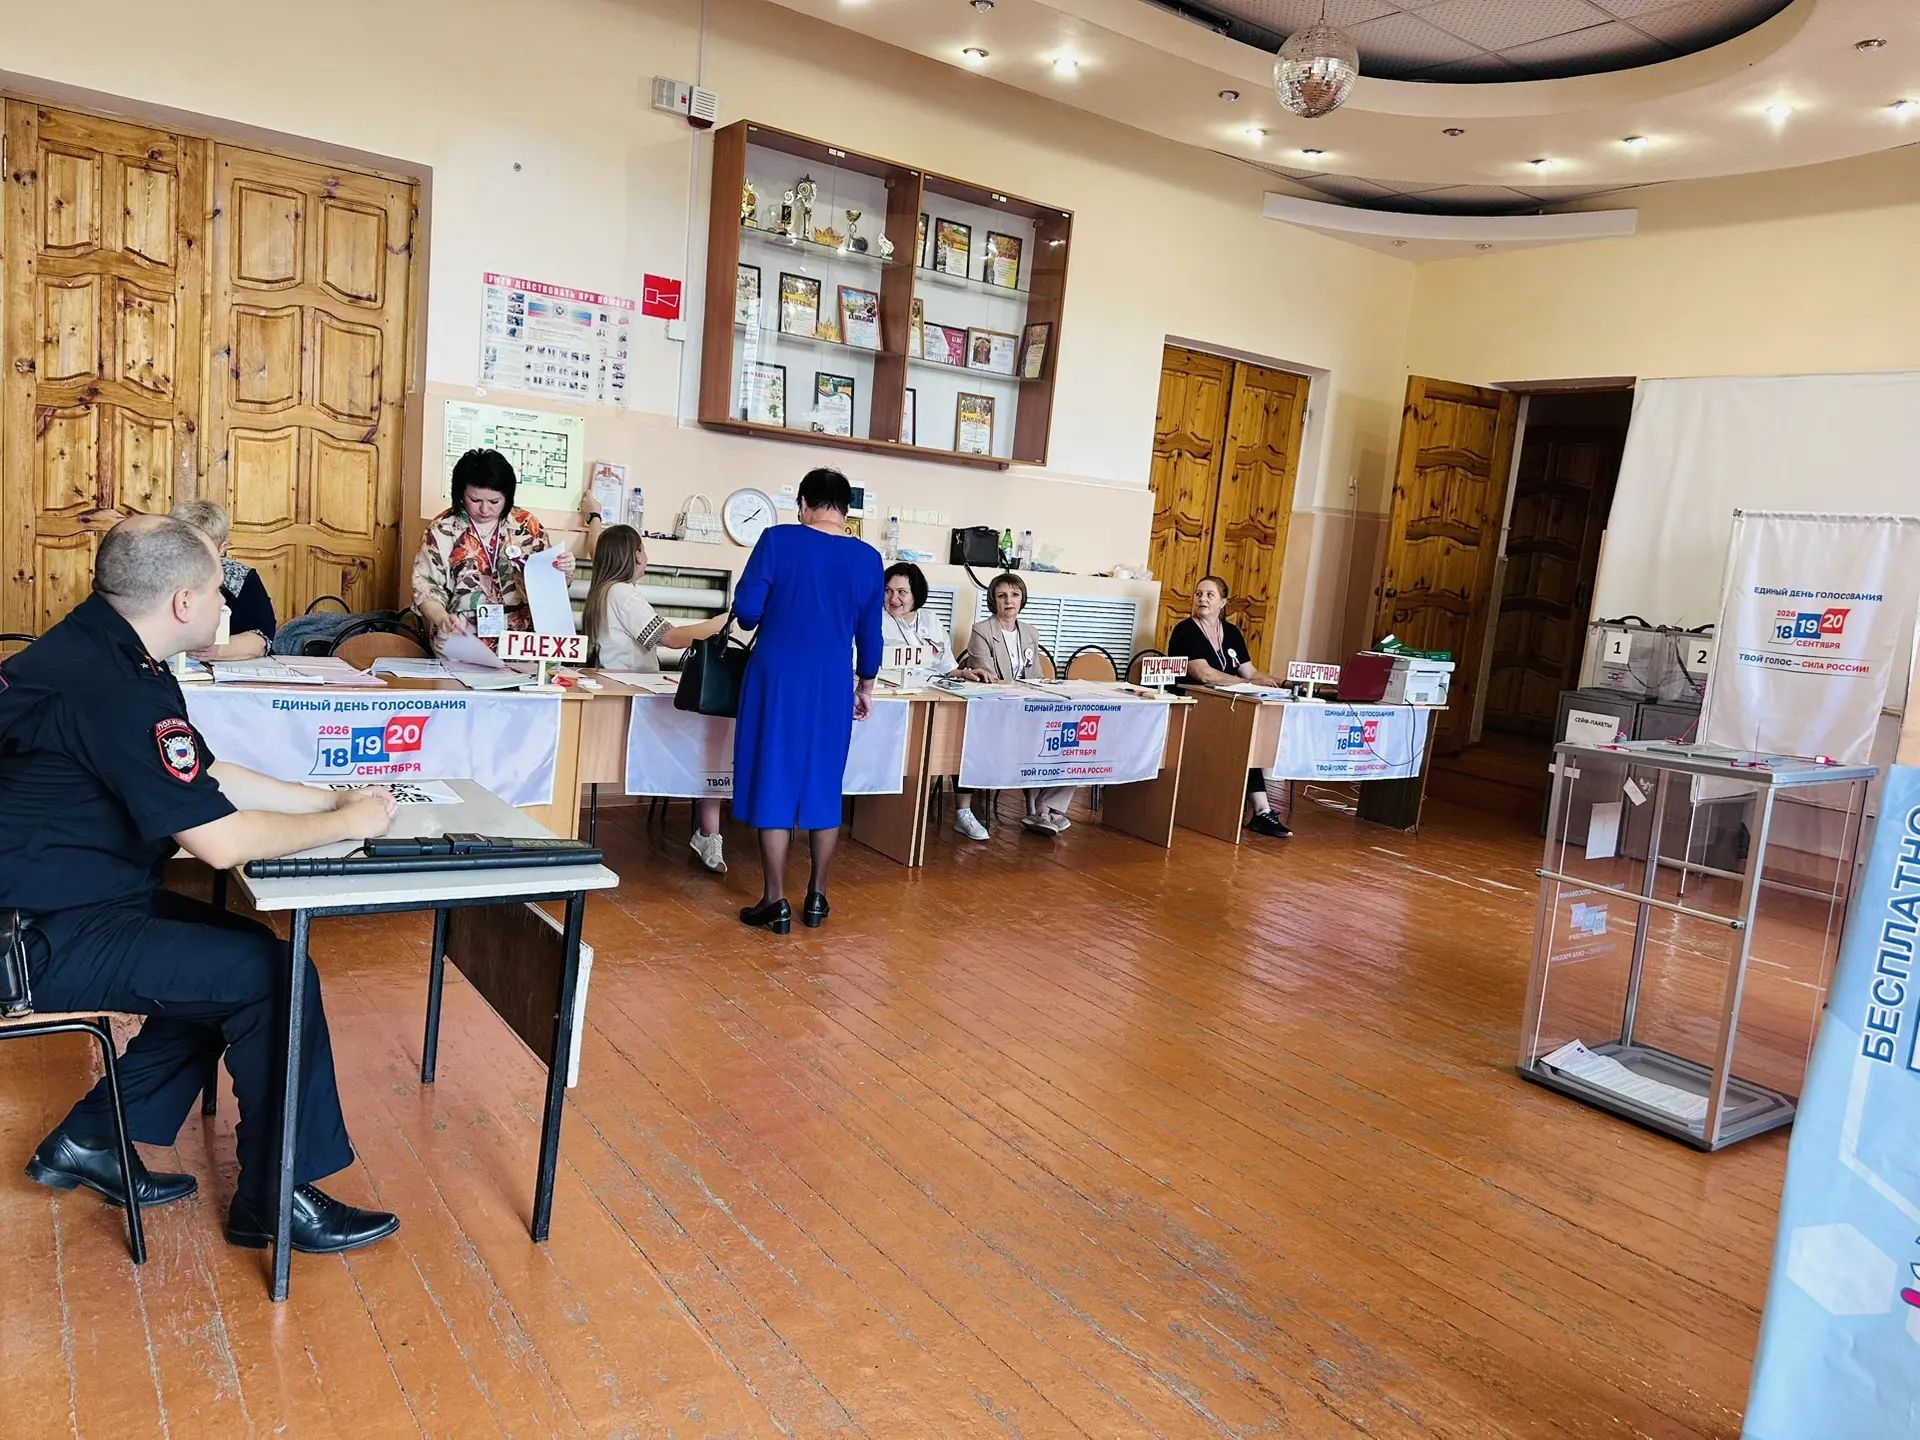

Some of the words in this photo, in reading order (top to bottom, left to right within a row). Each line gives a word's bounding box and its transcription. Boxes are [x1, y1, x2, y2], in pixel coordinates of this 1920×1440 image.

[515, 278, 576, 299] ДЕЙСТВОВАТЬ
[1753, 587, 1788, 596] ЕДИНЫЙ
[1789, 590, 1814, 598] ДЕНЬ
[1815, 591, 1883, 601] ГОЛОСОВАНИЯ
[1776, 625, 1792, 639] 18
[1798, 619, 1818, 633] 19
[1822, 614, 1843, 628] 20
[507, 634, 580, 658] ГДЕЖЗ
[1613, 641, 1621, 654] 1
[1796, 640, 1841, 649] СЕНТЯБРЯ
[1697, 650, 1707, 664] 2
[1739, 653, 1763, 663] ТВОЙ
[1764, 657, 1792, 667] ГОЛОС
[1802, 661, 1824, 669] СИЛА
[1827, 663, 1870, 673] РОССИИ!
[1290, 663, 1339, 681] СЕКРЕТАРЬ
[272, 699, 331, 711] ЕДИНЫЙ
[334, 700, 369, 712] ДЕНЬ
[372, 699, 466, 711] ГОЛОСОВАНИЯ
[1024, 704, 1053, 713] ЕДИНЫЙ
[1575, 716, 1613, 728] СЕЙФ-ПАКЕТЫ
[318, 726, 350, 735] 2026
[1046, 737, 1060, 751] 18
[1062, 728, 1076, 742] 19
[1079, 721, 1097, 735] 20
[1337, 738, 1347, 750] 18
[1350, 731, 1361, 743] 19
[1364, 726, 1376, 737] 20
[321, 747, 349, 767] 18
[355, 735, 381, 755] 19
[387, 725, 420, 744] 20
[357, 763, 421, 775] СЕНТЯБРЯ
[1021, 768, 1036, 777] ТВОЙ
[1038, 768, 1060, 776] ГОЛОС
[706, 776, 731, 787] ТВОЙ
